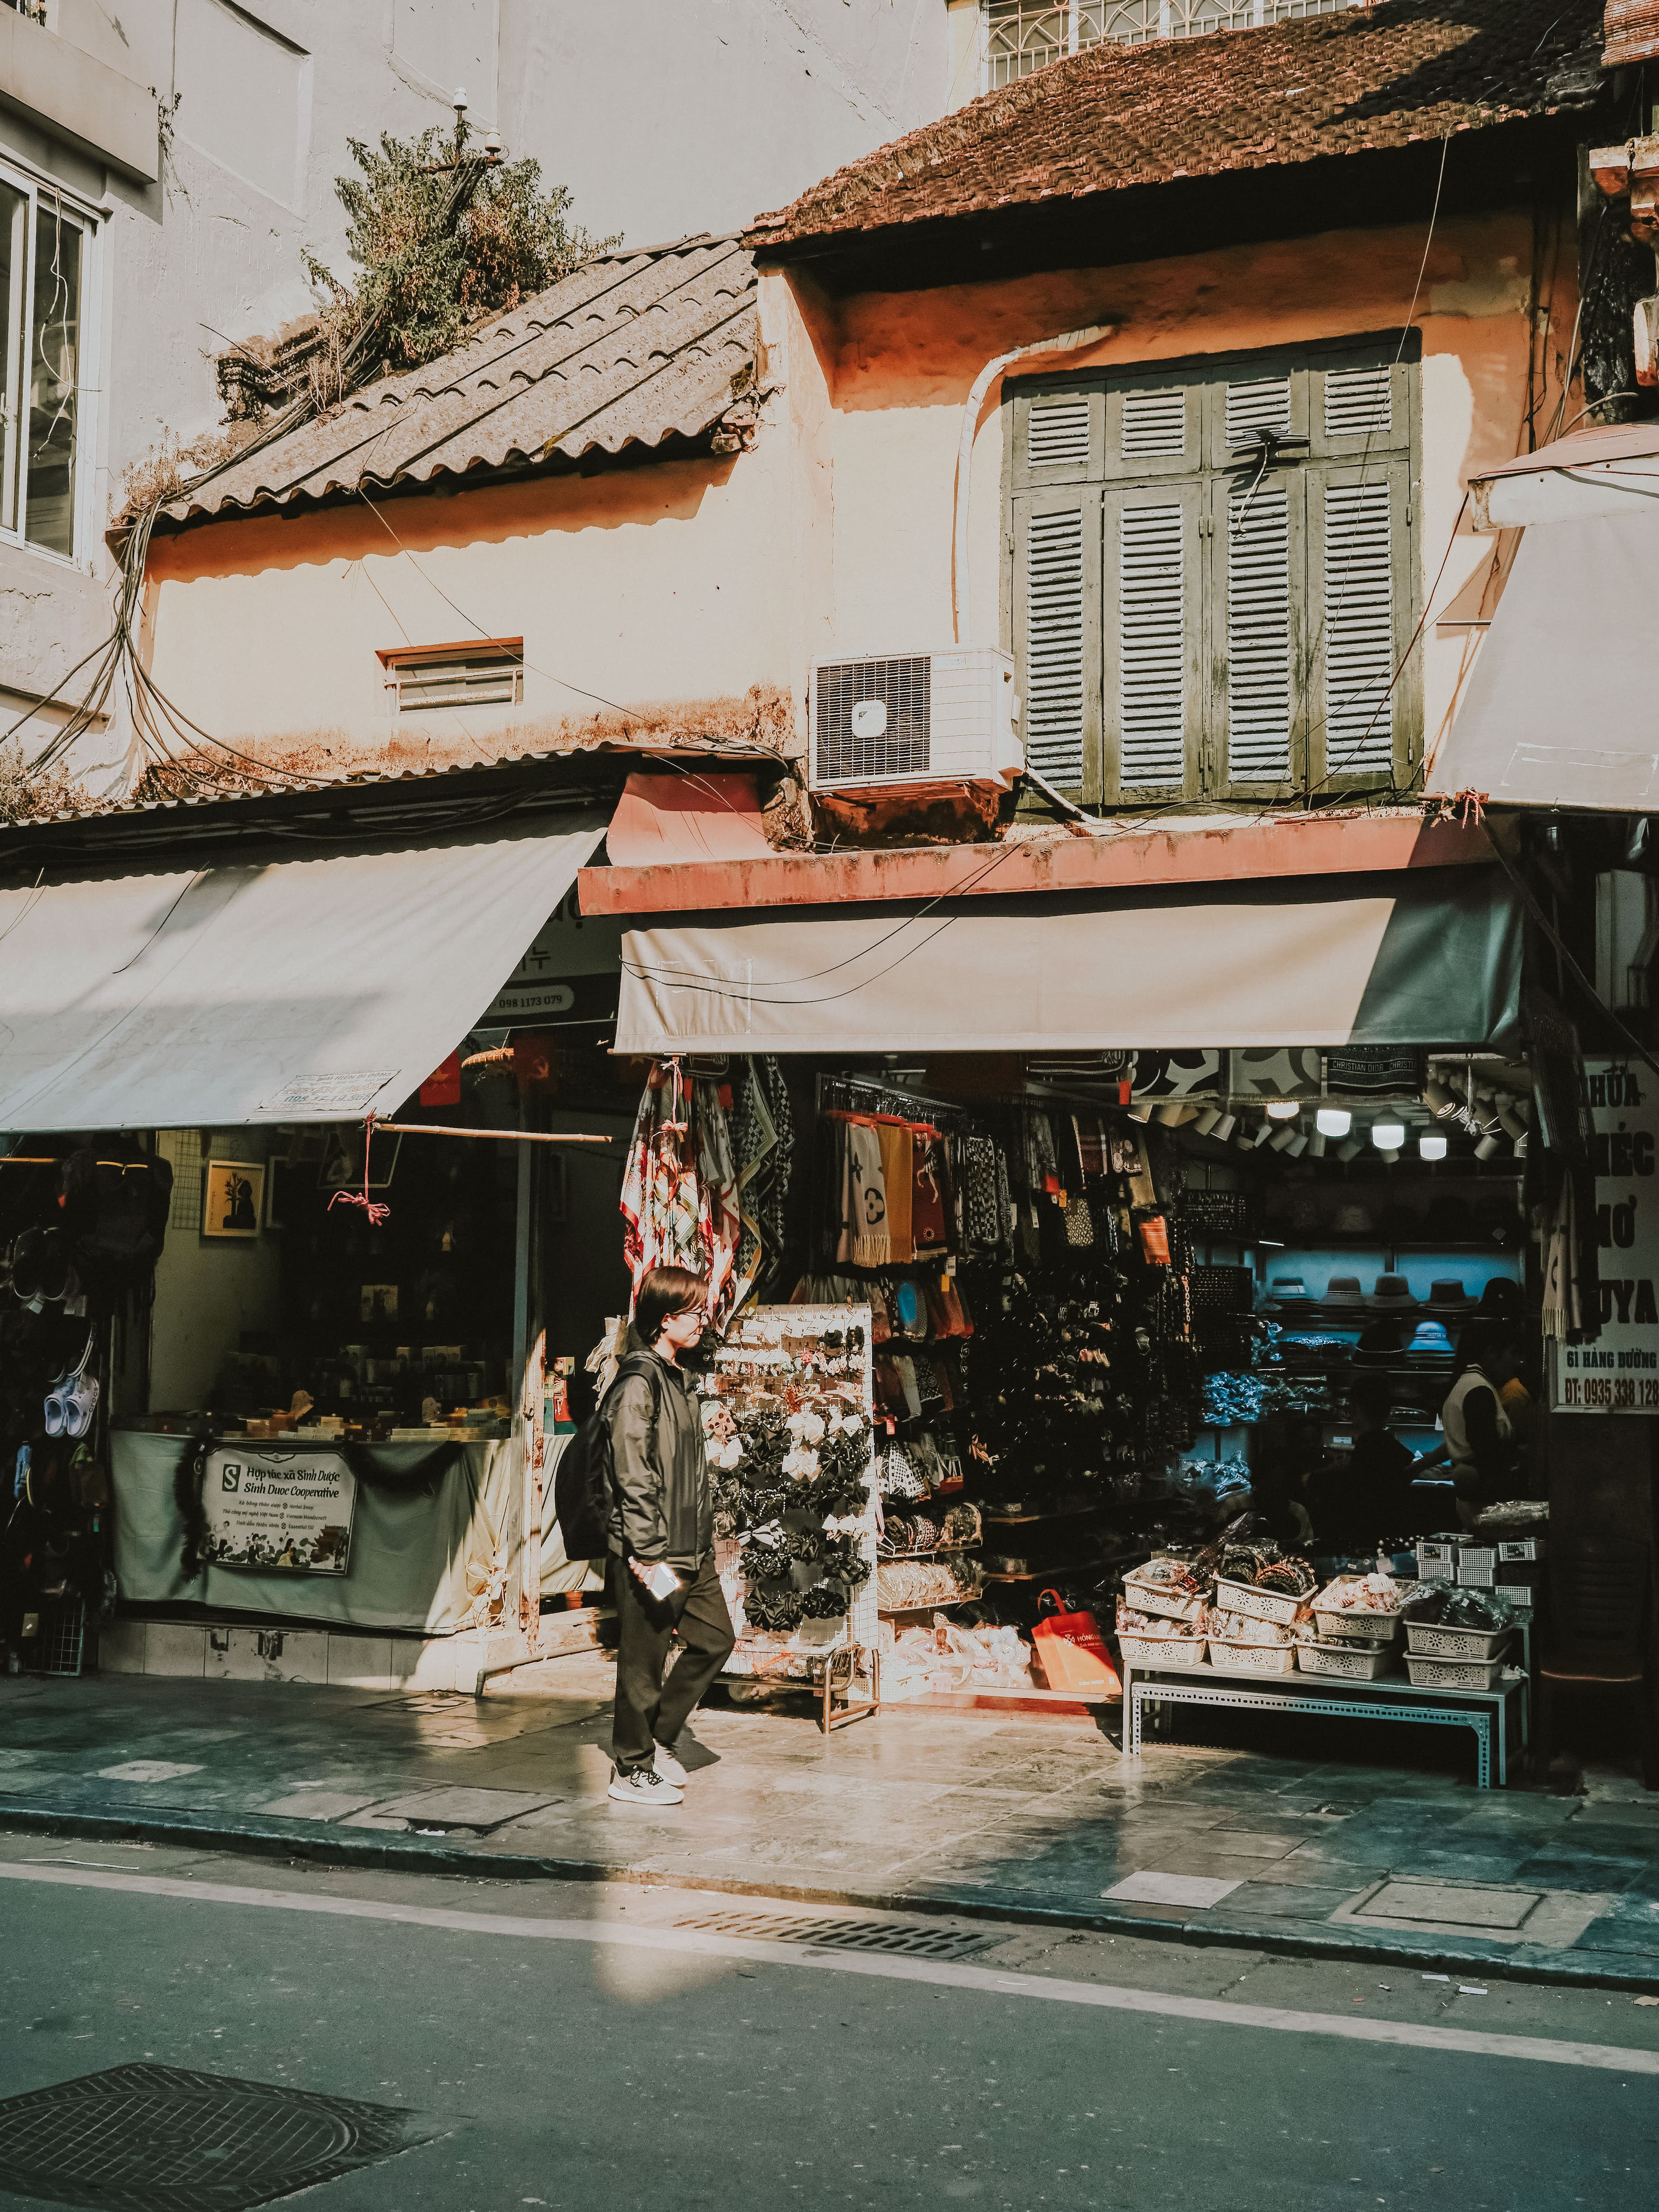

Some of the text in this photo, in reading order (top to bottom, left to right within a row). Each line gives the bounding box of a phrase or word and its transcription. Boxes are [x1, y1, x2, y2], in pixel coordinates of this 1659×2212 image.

[522, 947, 551, 972] 누
[499, 995, 562, 1008] 098 1173 079
[1333, 1060, 1417, 1072] CHRISTIAN DIOR CHRISTIA
[1567, 1347, 1657, 1369] 61 HÀNG ĐƯỜNG
[89, 1386, 99, 1413] crocs
[1565, 1378, 1659, 1405] ĐT: 0935 338 128
[247, 1466, 266, 1482] Hợp
[267, 1469, 282, 1480] tác
[284, 1470, 296, 1480] xã
[297, 1469, 317, 1481] Sinh
[318, 1471, 340, 1485] Dược
[244, 1482, 340, 1500] Sinh Duoc Cooperative
